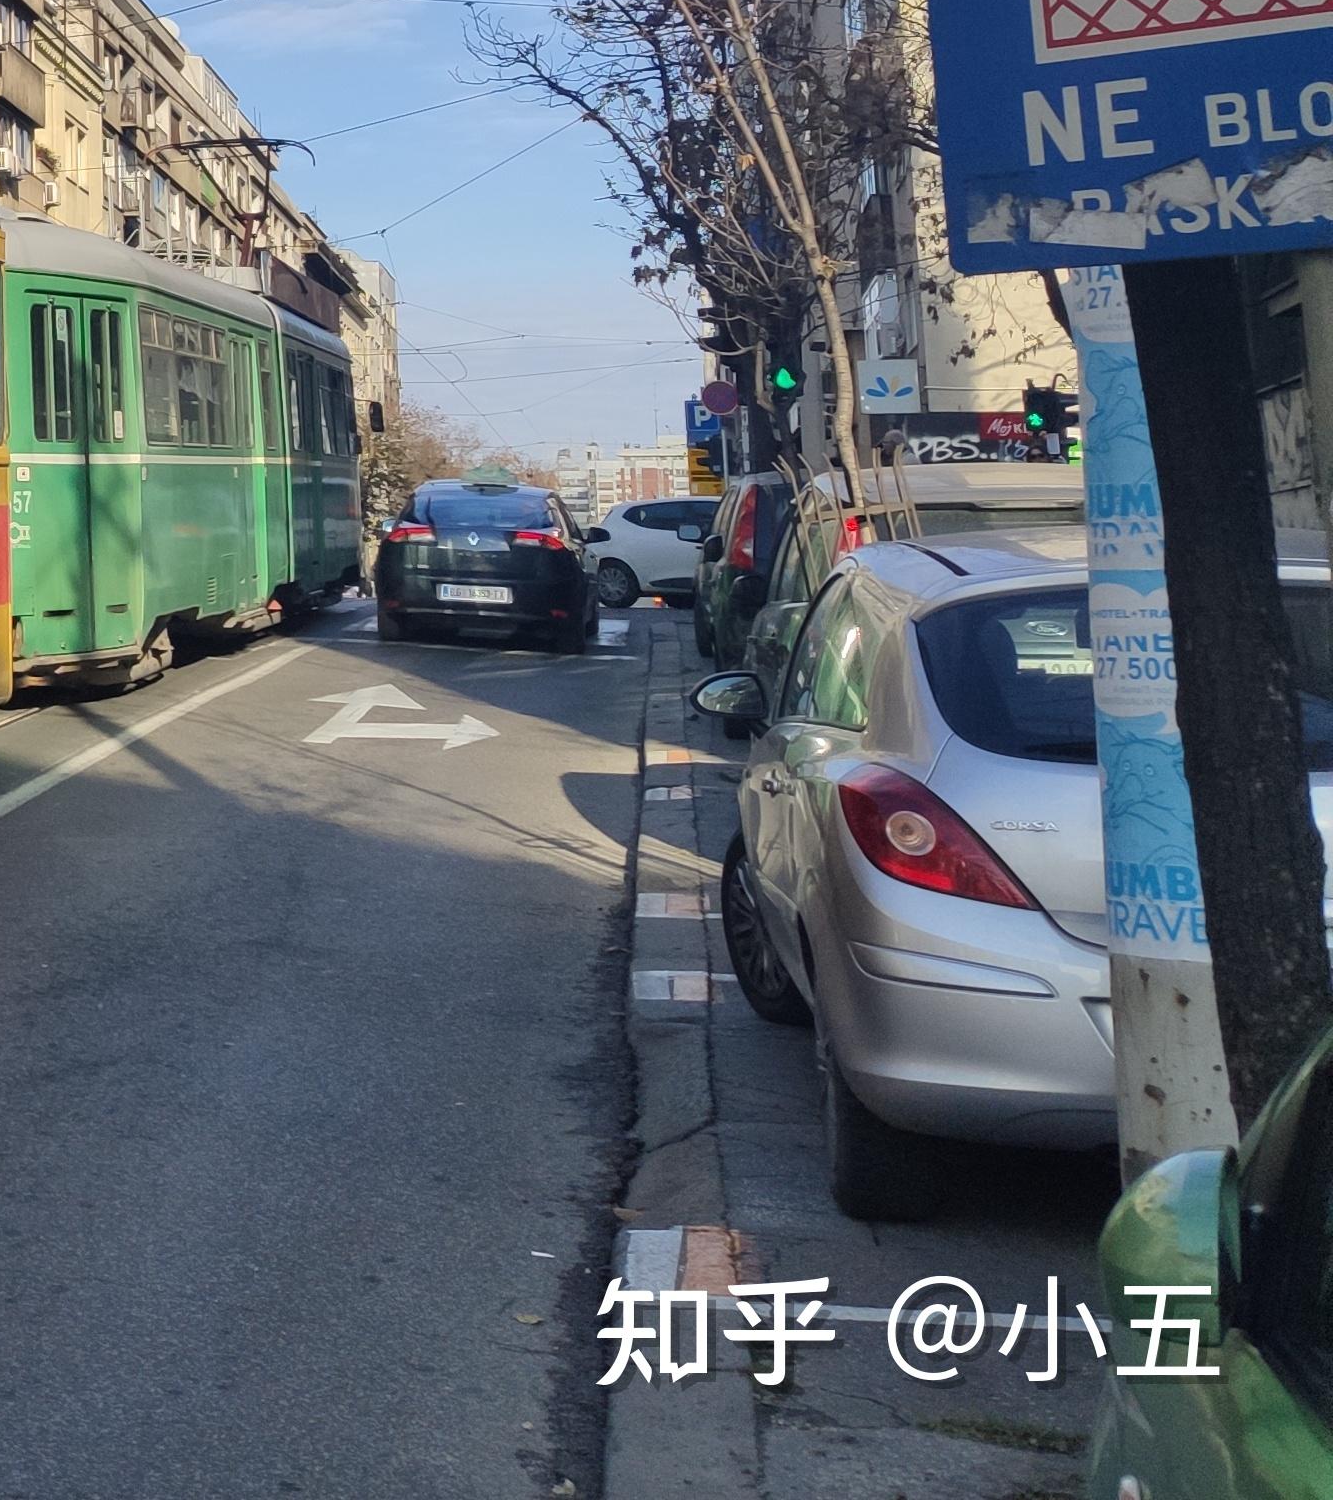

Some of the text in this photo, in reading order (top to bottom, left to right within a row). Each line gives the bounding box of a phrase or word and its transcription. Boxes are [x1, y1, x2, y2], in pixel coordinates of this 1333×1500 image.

[1022, 77, 1333, 166] NE BLO
[12, 490, 32, 514] 57
[990, 820, 1060, 833] CORSA
